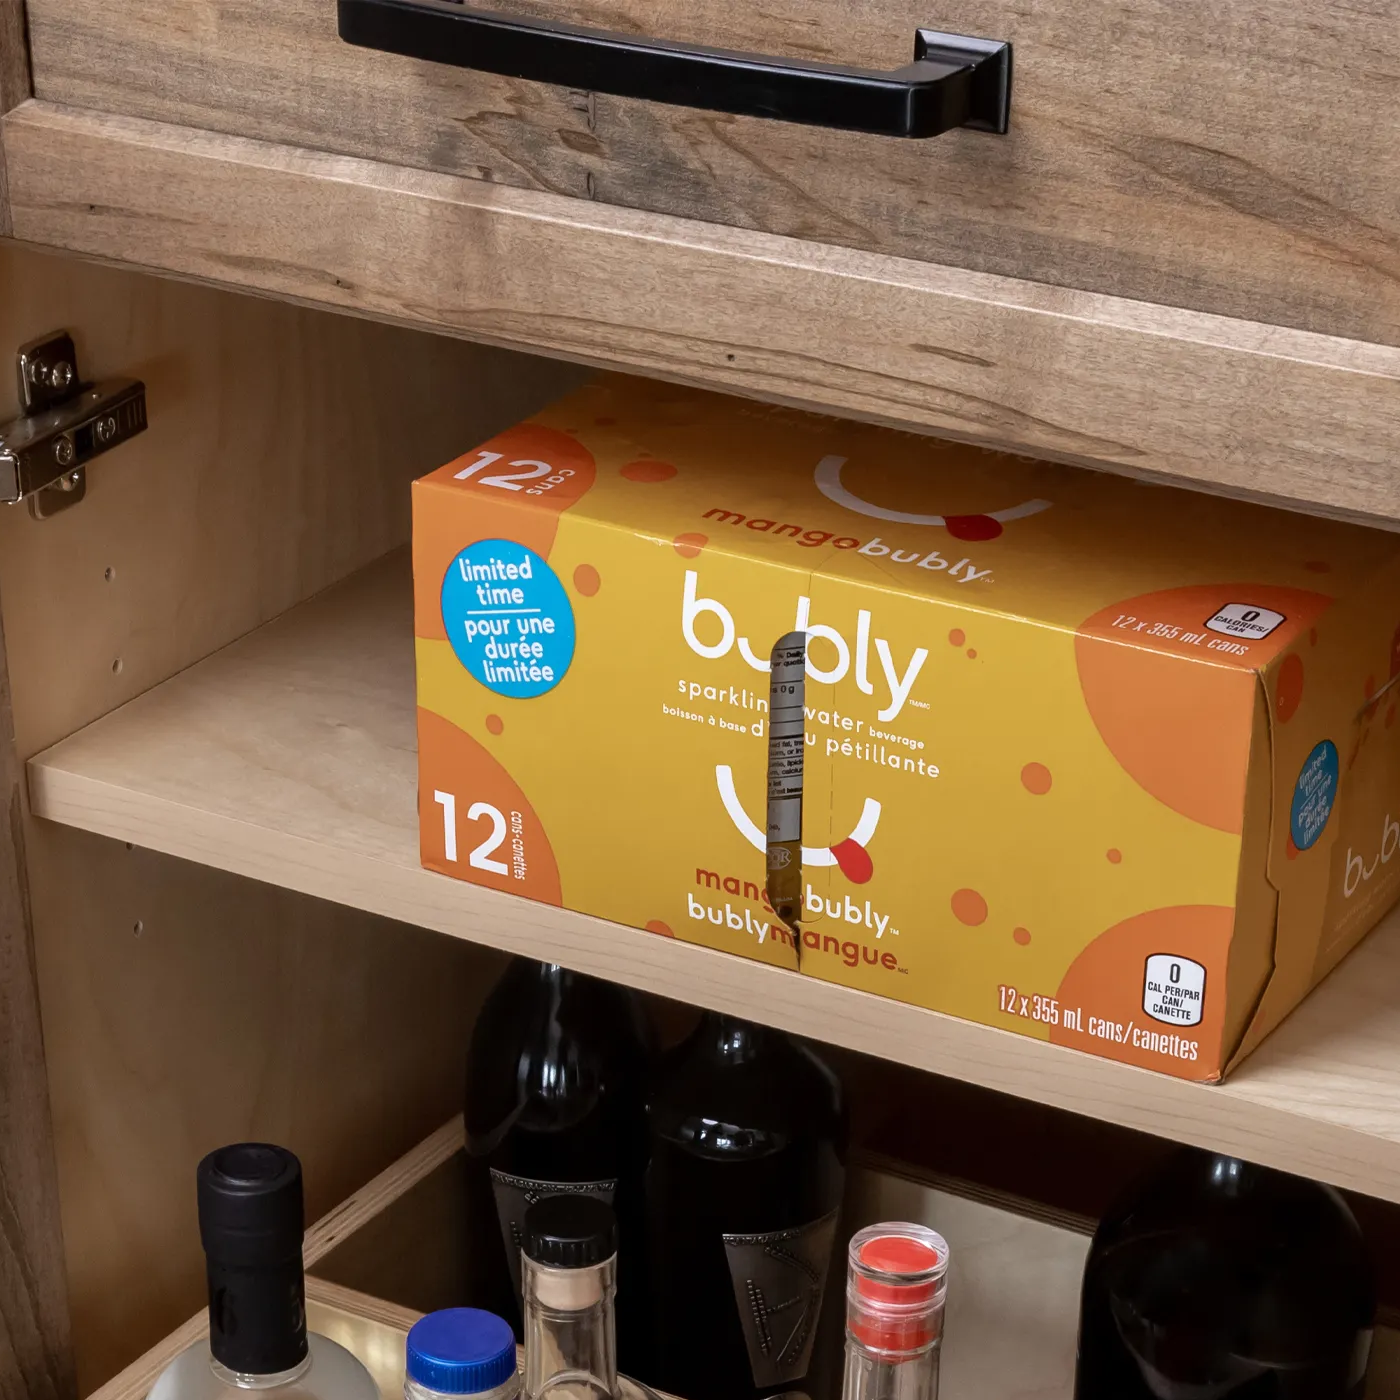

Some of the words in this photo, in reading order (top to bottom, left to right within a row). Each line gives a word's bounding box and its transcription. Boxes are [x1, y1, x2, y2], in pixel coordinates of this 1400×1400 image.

[453, 451, 552, 491] 12
[526, 469, 576, 495] cans
[701, 508, 993, 583] mangobubly
[459, 554, 532, 582] limited
[476, 583, 524, 605] time
[1226, 625, 1246, 633] CAN
[1241, 611, 1260, 622] 0
[464, 619, 510, 643] pour
[516, 617, 555, 634] une
[1112, 615, 1136, 629] 12
[1134, 622, 1147, 632] x
[1147, 623, 1183, 639] 355
[1179, 633, 1207, 646] mL
[1207, 639, 1249, 656] cans
[485, 635, 543, 659] durée
[682, 569, 929, 722] bubly
[482, 659, 554, 683] limitée
[678, 678, 770, 713] sparklin
[802, 706, 864, 733] water
[869, 726, 925, 750] beverage
[662, 703, 704, 724] boisson
[708, 715, 715, 726] à
[719, 716, 746, 733] base
[827, 736, 940, 778] pétillante
[434, 789, 509, 876] 12
[1170, 963, 1180, 984] 0
[1147, 981, 1162, 994] CAL
[1164, 985, 1200, 1001] PER/PAR
[1161, 995, 1184, 1008] CAN/
[998, 986, 1016, 1015] 12
[1019, 997, 1030, 1017] x
[1032, 995, 1059, 1025] 355
[1063, 1007, 1085, 1032] mL
[1088, 1021, 1199, 1061] cans/canettes
[1152, 1003, 1191, 1021] CANETTE
